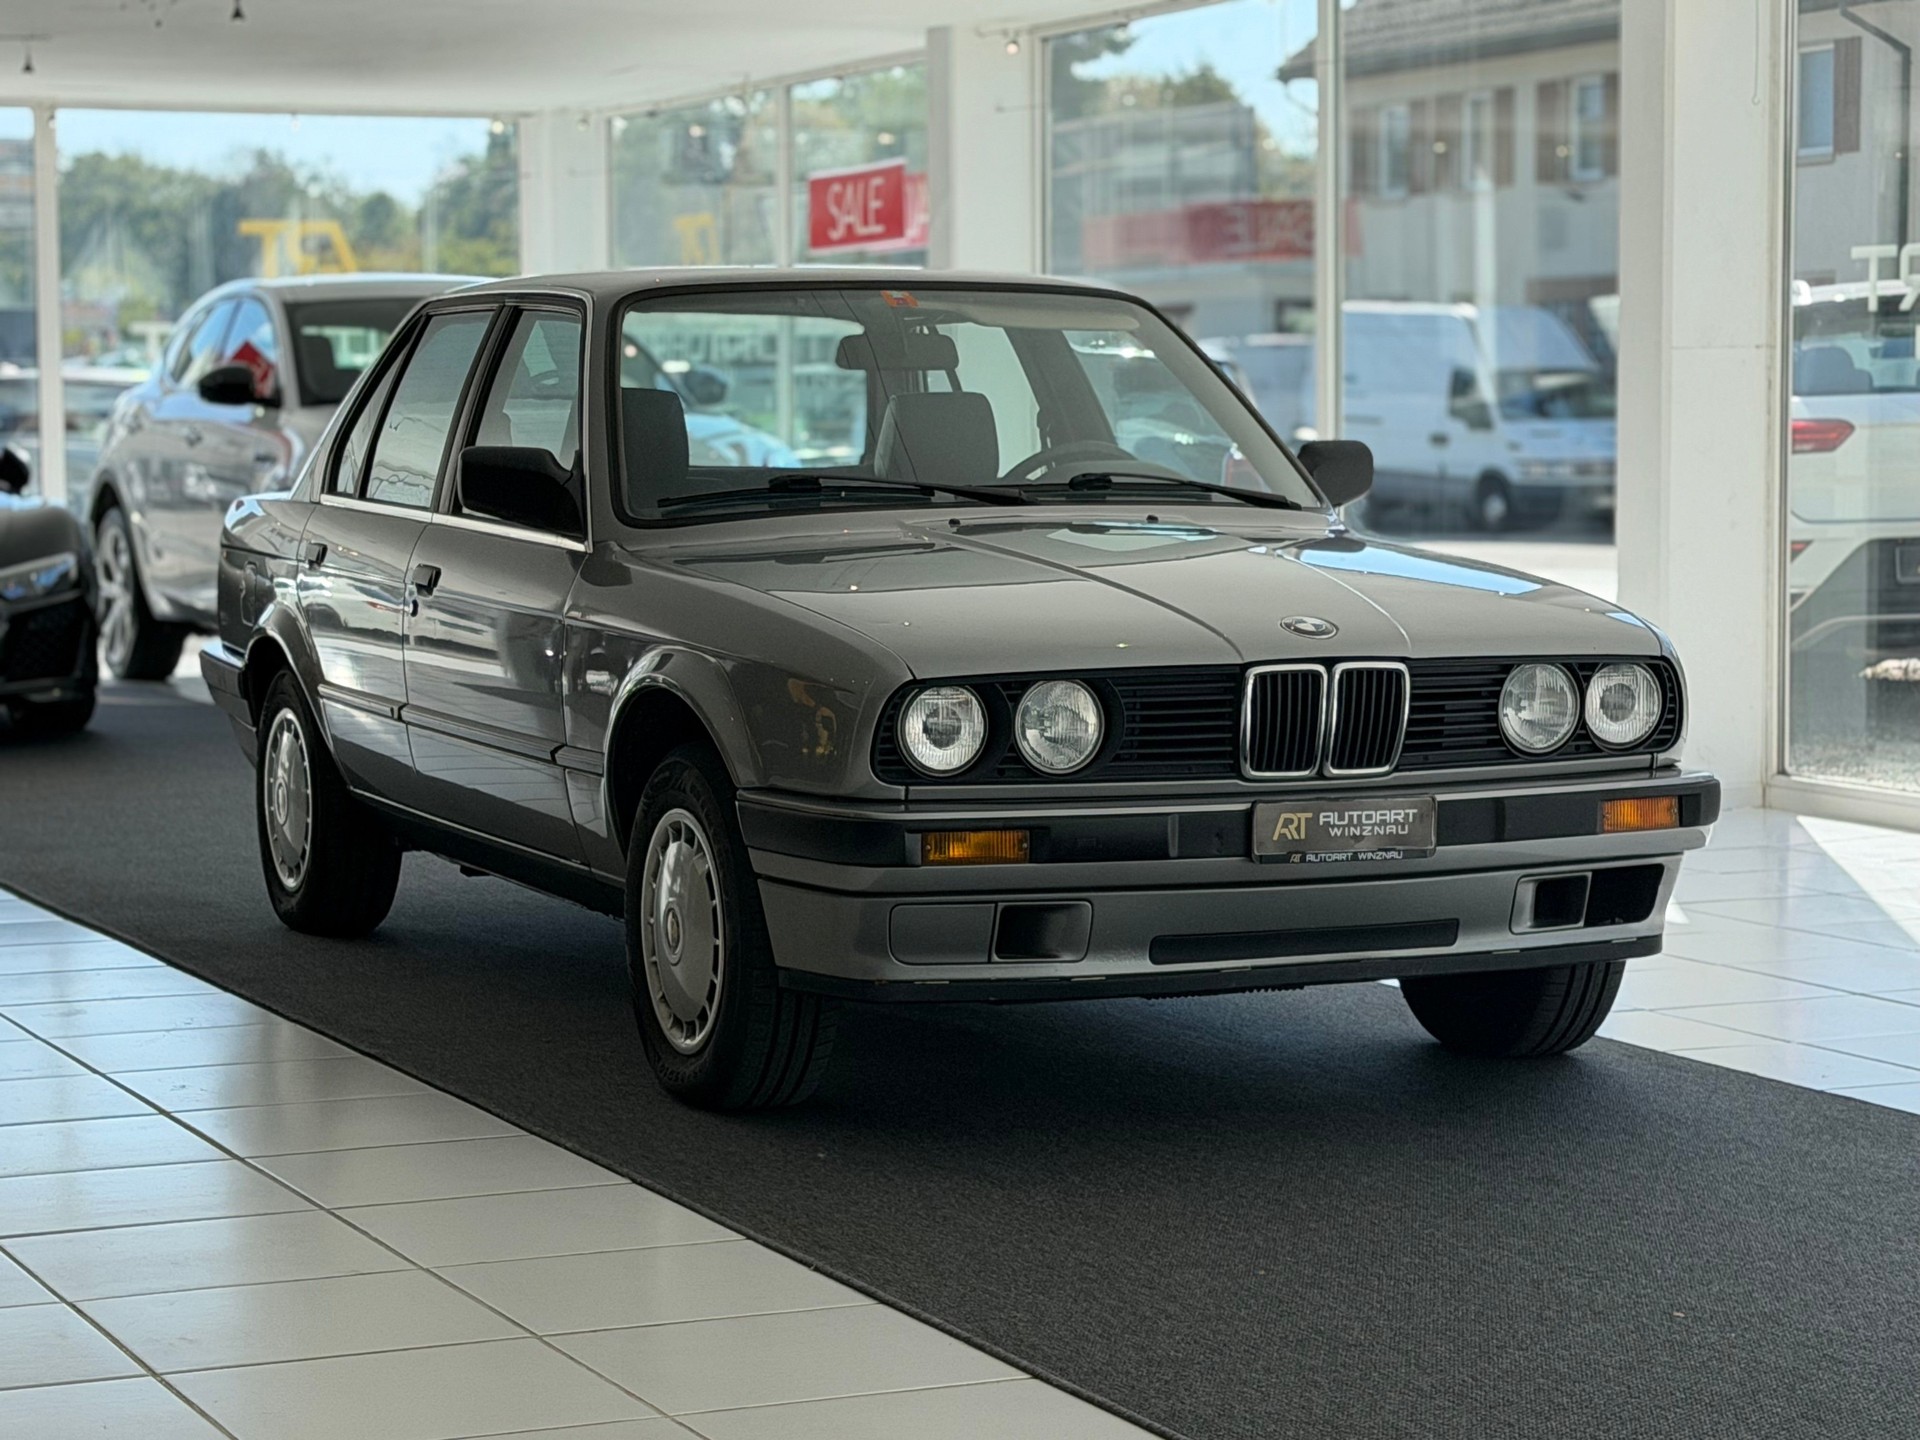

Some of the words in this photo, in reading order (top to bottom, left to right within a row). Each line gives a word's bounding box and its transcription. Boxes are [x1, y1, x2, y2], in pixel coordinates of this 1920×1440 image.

[826, 177, 886, 241] SALE
[1319, 809, 1418, 826] AUTOART
[1328, 824, 1409, 837] WINZNAU
[1305, 852, 1353, 863] AUTOART
[1357, 851, 1403, 861] WINZNAU
